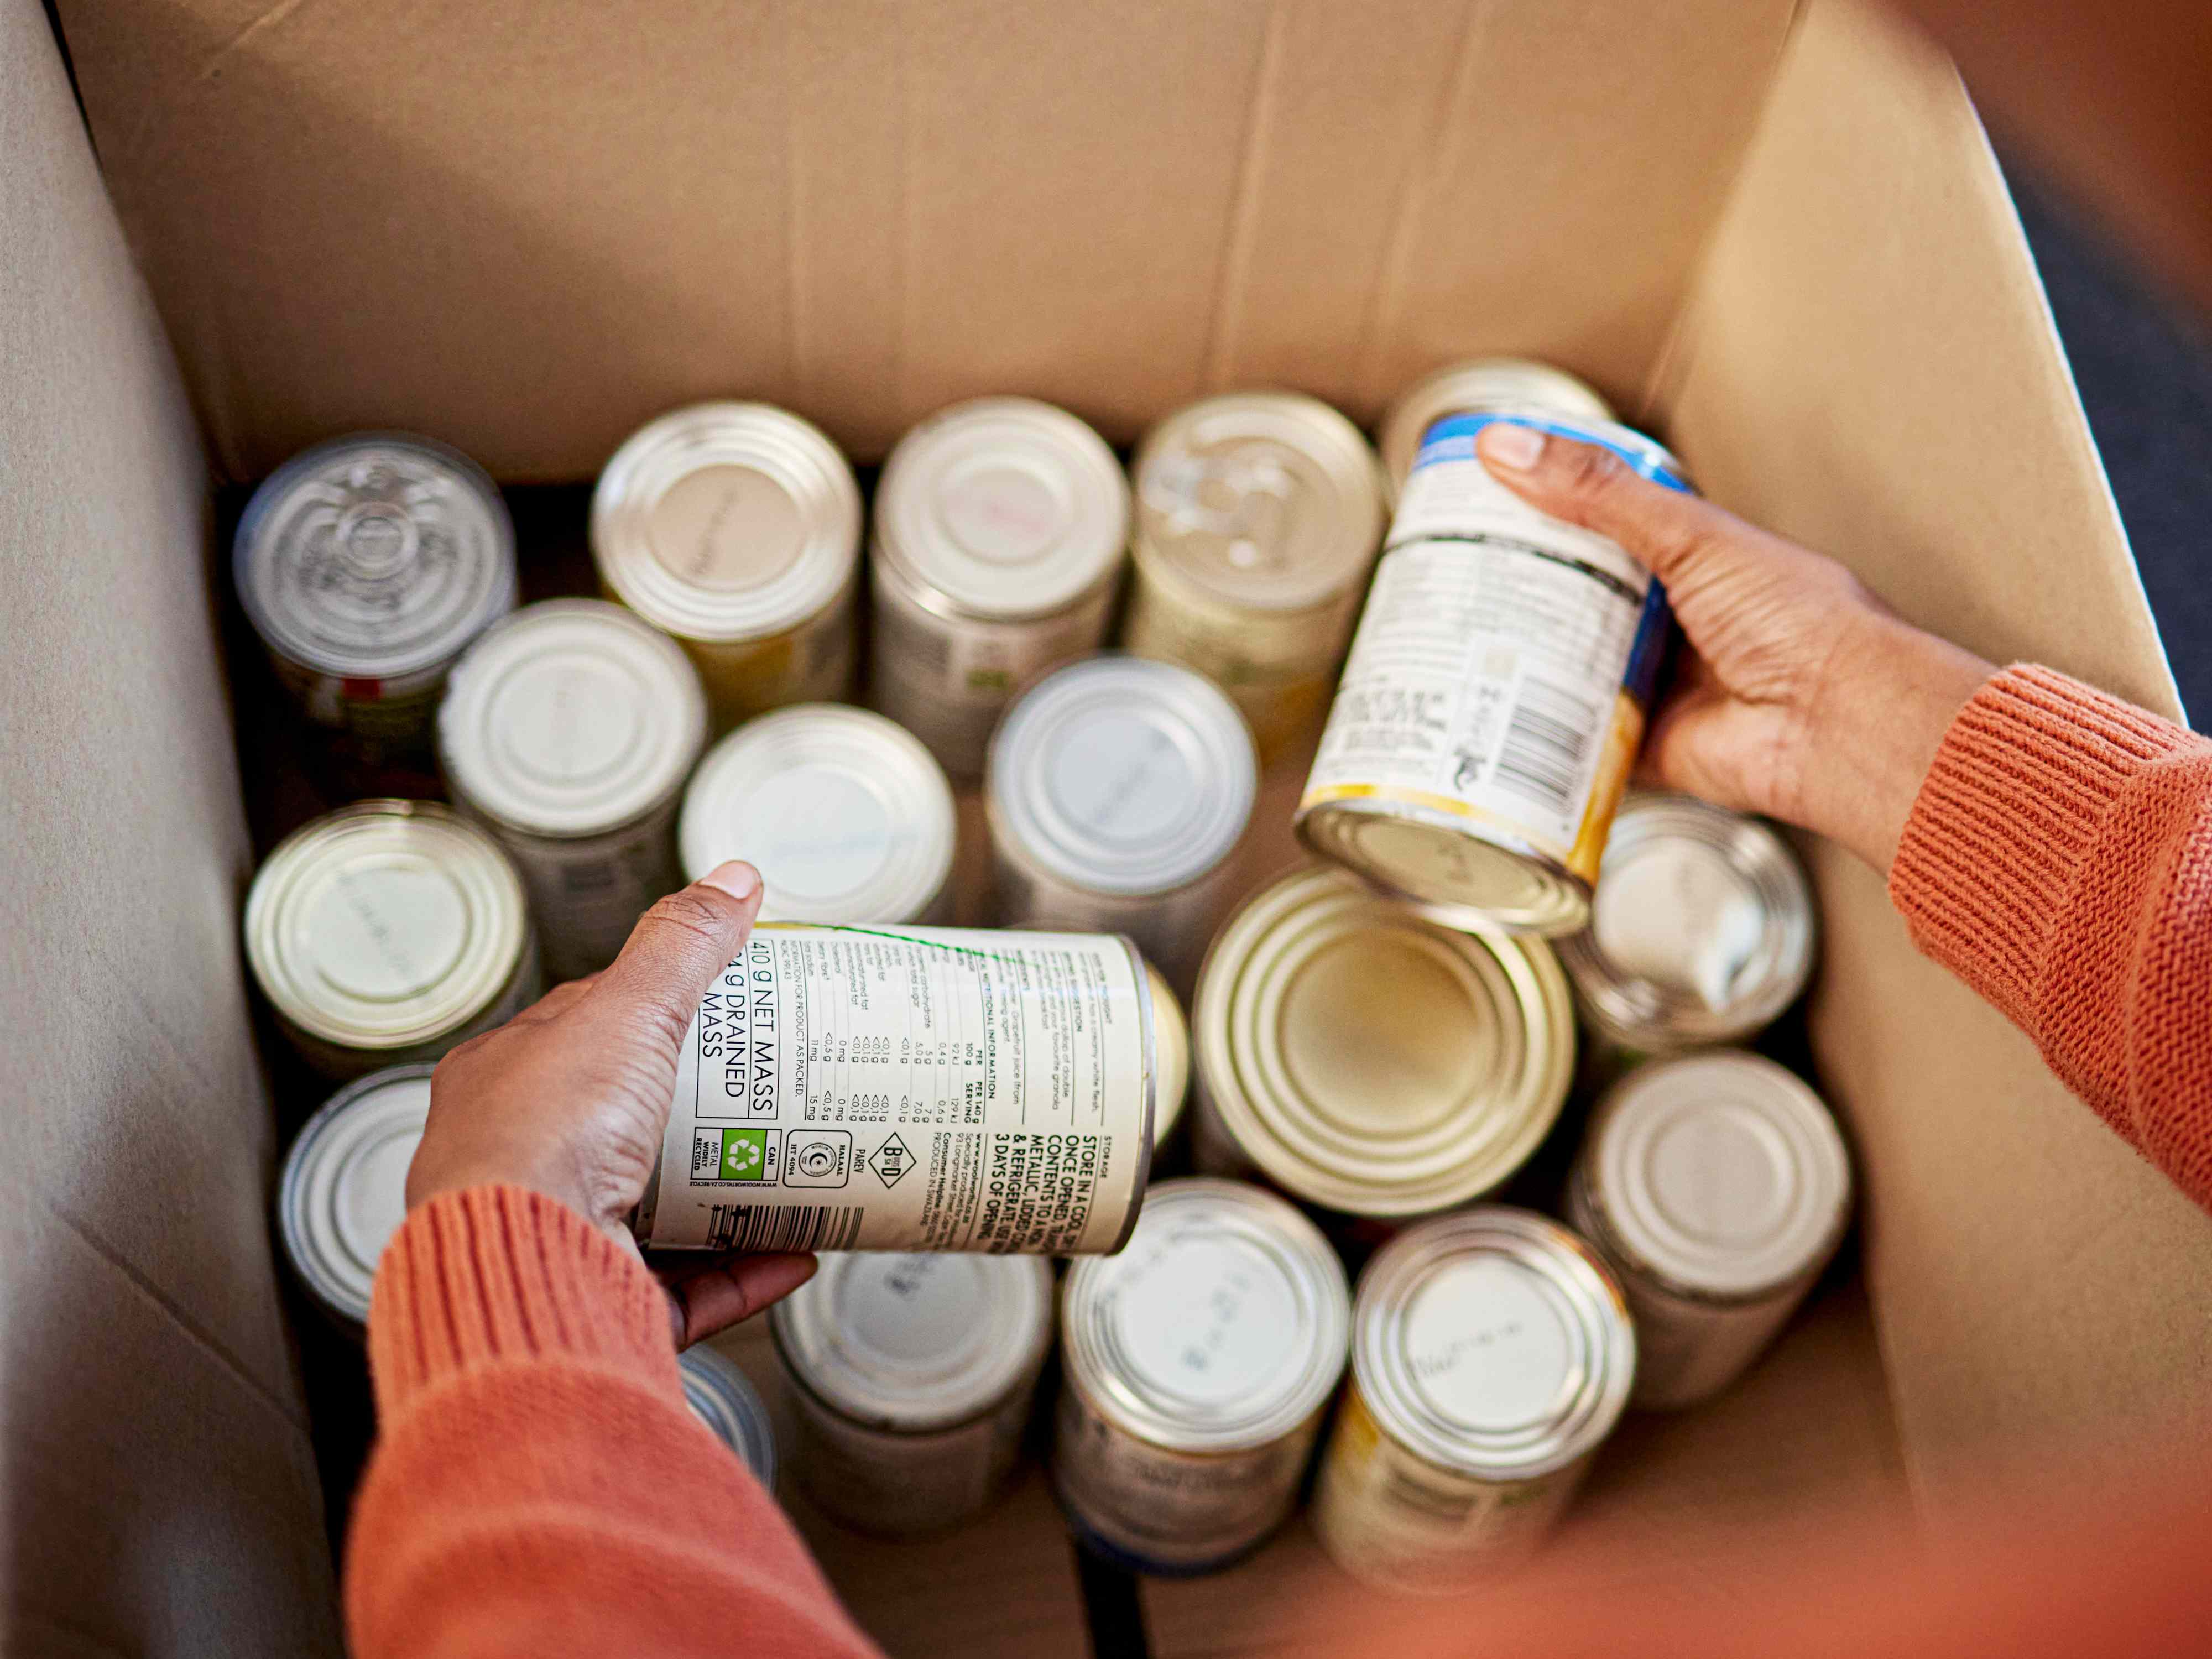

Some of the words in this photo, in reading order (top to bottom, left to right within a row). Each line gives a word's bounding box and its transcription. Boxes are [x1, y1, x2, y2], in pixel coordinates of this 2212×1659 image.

[752, 942, 771, 964] 410
[725, 975, 745, 987] g
[753, 971, 772, 982] g
[794, 984, 804, 999] FOR
[911, 987, 920, 1008] sugar
[753, 990, 774, 1032] NET
[861, 999, 869, 1010] fat
[920, 975, 931, 1029] carbohydrate
[703, 992, 722, 1058] MASS
[795, 1001, 805, 1043] PRODUCT
[726, 995, 746, 1097] DRAINED
[824, 1032, 833, 1053] <0,5
[852, 1036, 861, 1054] <0,1
[862, 1036, 871, 1055] <0,1
[872, 1036, 880, 1055] <0,1
[881, 1037, 890, 1055] <0,1
[900, 1037, 910, 1055] <0,1
[1061, 1025, 1070, 1051] dollop
[796, 1045, 804, 1057] AS
[809, 1047, 818, 1061] mg
[837, 1048, 846, 1062] mg
[914, 1042, 924, 1056] 5,0
[937, 1042, 947, 1056] 0,4
[952, 1043, 960, 1054] 92
[952, 1056, 960, 1065] kJ
[987, 1029, 996, 1099] INFORMATION
[1012, 1058, 1021, 1078] juice
[1062, 1054, 1070, 1063] of
[753, 1041, 775, 1112] MASS
[795, 1059, 804, 1097] PACKED.
[810, 1095, 818, 1104] 15
[823, 1090, 832, 1112] <0,5
[1052, 1074, 1061, 1110] granola
[851, 1094, 859, 1113] <0,1
[860, 1094, 870, 1113] <0,1
[870, 1094, 879, 1113] <0,1
[880, 1094, 889, 1113] <0,1
[899, 1095, 909, 1114] <0,1
[914, 1101, 923, 1114] 7,0
[937, 1100, 946, 1114] 0,6
[964, 1083, 973, 1124] SERVING
[807, 1107, 816, 1121] mg
[835, 1107, 844, 1121] mg
[950, 1114, 959, 1124] kJ
[955, 1132, 964, 1142] 93
[995, 1133, 1010, 1141] 3
[1013, 1134, 1027, 1144] &
[693, 1137, 703, 1171] RECYCLED
[701, 1141, 709, 1168] WIDELY
[709, 1142, 719, 1168] METAL
[768, 1146, 776, 1165] CAN
[790, 1144, 797, 1155] HT
[929, 1132, 942, 1177] PRODUCED
[940, 1132, 951, 1176] Consumer
[961, 1133, 974, 1170] Specially
[1062, 1135, 1080, 1173] ONCE
[1079, 1135, 1097, 1177] STORE
[1100, 1136, 1112, 1178] STORAGE
[836, 1144, 846, 1177] HALAAL
[853, 1149, 866, 1173] PAREV
[951, 1145, 963, 1191] Longmarket
[991, 1145, 1009, 1178] DAYS
[1021, 1134, 1045, 1197] METALLIC,
[1040, 1134, 1062, 1202] CONTENTS
[927, 1179, 937, 1188] IN
[957, 1172, 970, 1208] produced
[989, 1181, 1005, 1197] OF
[1077, 1180, 1091, 1193] IN
[1051, 1177, 1074, 1223] OPENED,
[1015, 1199, 1036, 1232] LIDDED
[1036, 1204, 1053, 1218] TO
